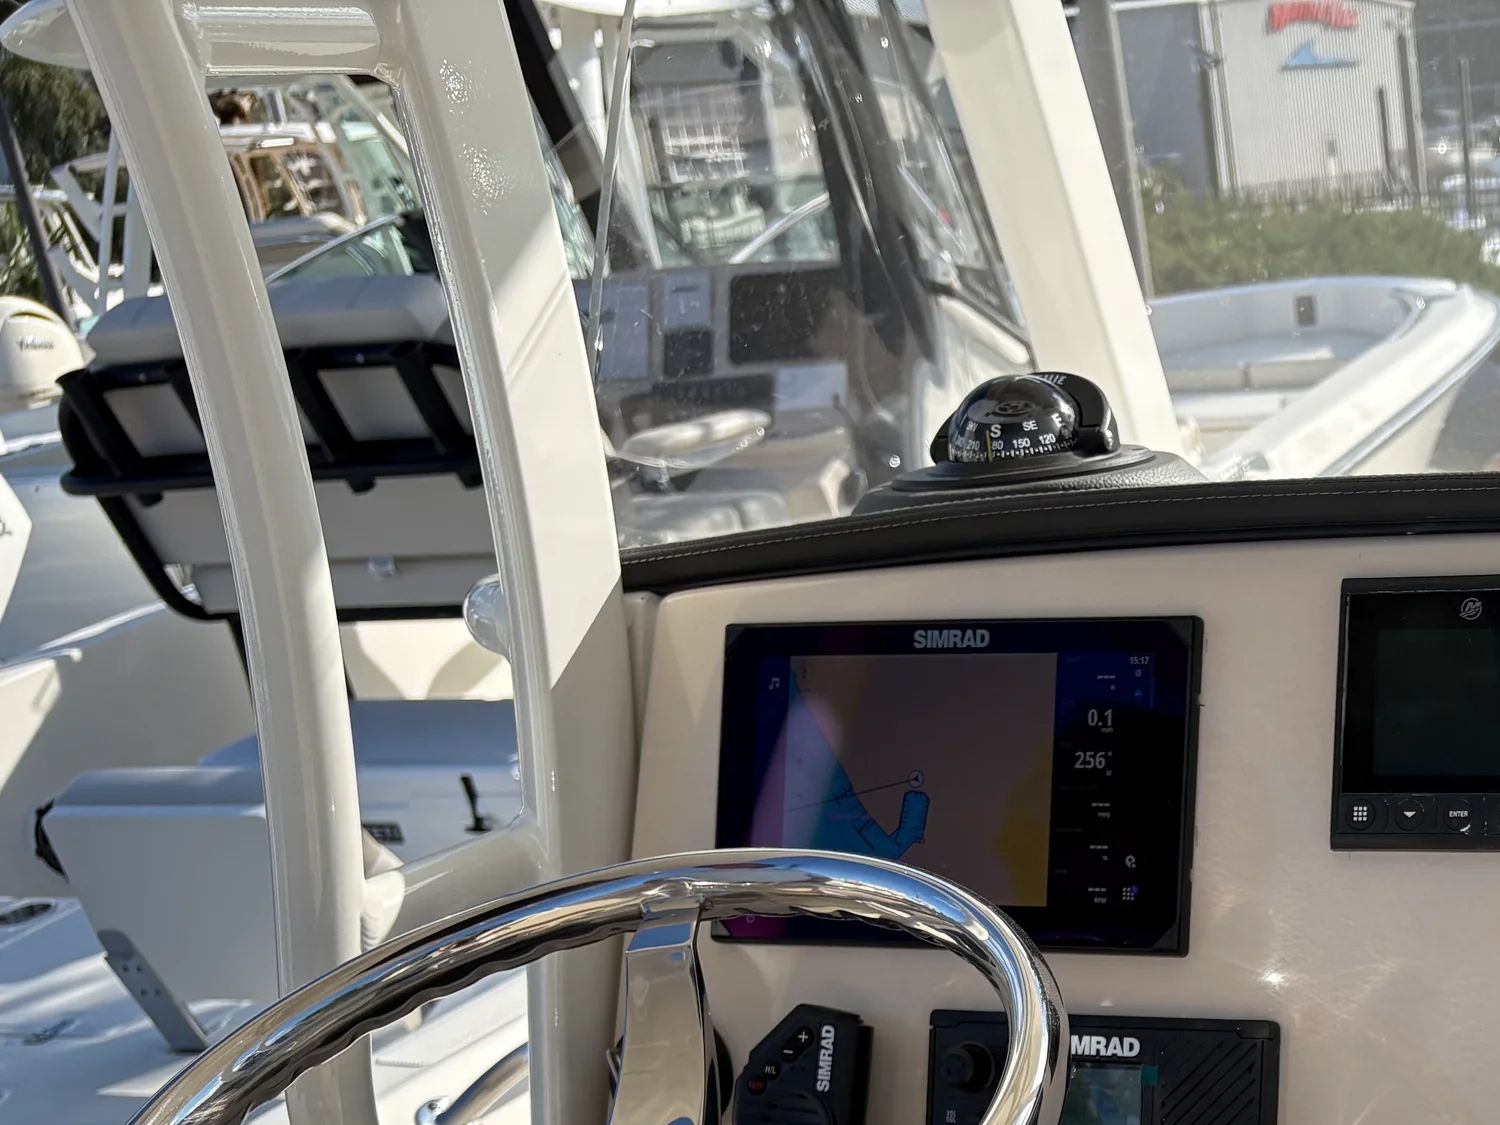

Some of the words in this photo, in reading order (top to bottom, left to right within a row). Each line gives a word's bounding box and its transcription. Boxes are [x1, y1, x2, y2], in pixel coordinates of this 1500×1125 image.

[1023, 420, 1038, 431] SE
[1013, 437, 1031, 449] 150
[1039, 433, 1056, 445] 120
[913, 629, 991, 649] SIMRAD
[1129, 656, 1150, 665] 15:17
[1087, 708, 1113, 727] 0.1
[1449, 810, 1469, 818] ENTER
[1071, 1035, 1141, 1058] MRAD
[816, 1024, 836, 1093] SIMRAD
